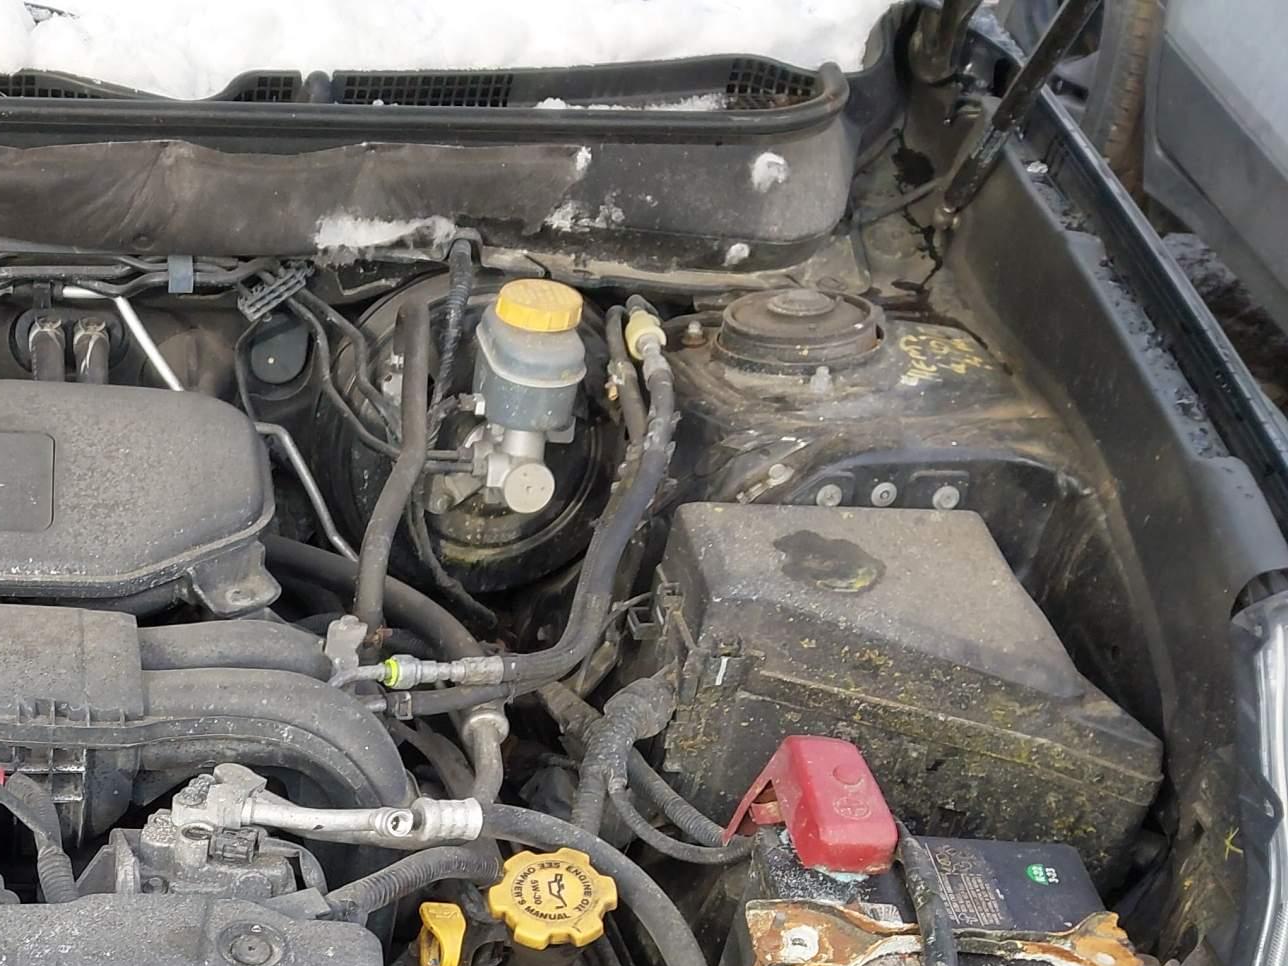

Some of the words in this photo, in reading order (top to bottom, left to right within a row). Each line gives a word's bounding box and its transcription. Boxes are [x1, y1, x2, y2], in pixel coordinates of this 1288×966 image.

[566, 865, 592, 897] ENGINE
[530, 879, 543, 905] 5W-30
[525, 905, 570, 920] MANUAL
[573, 898, 590, 912] OIL
